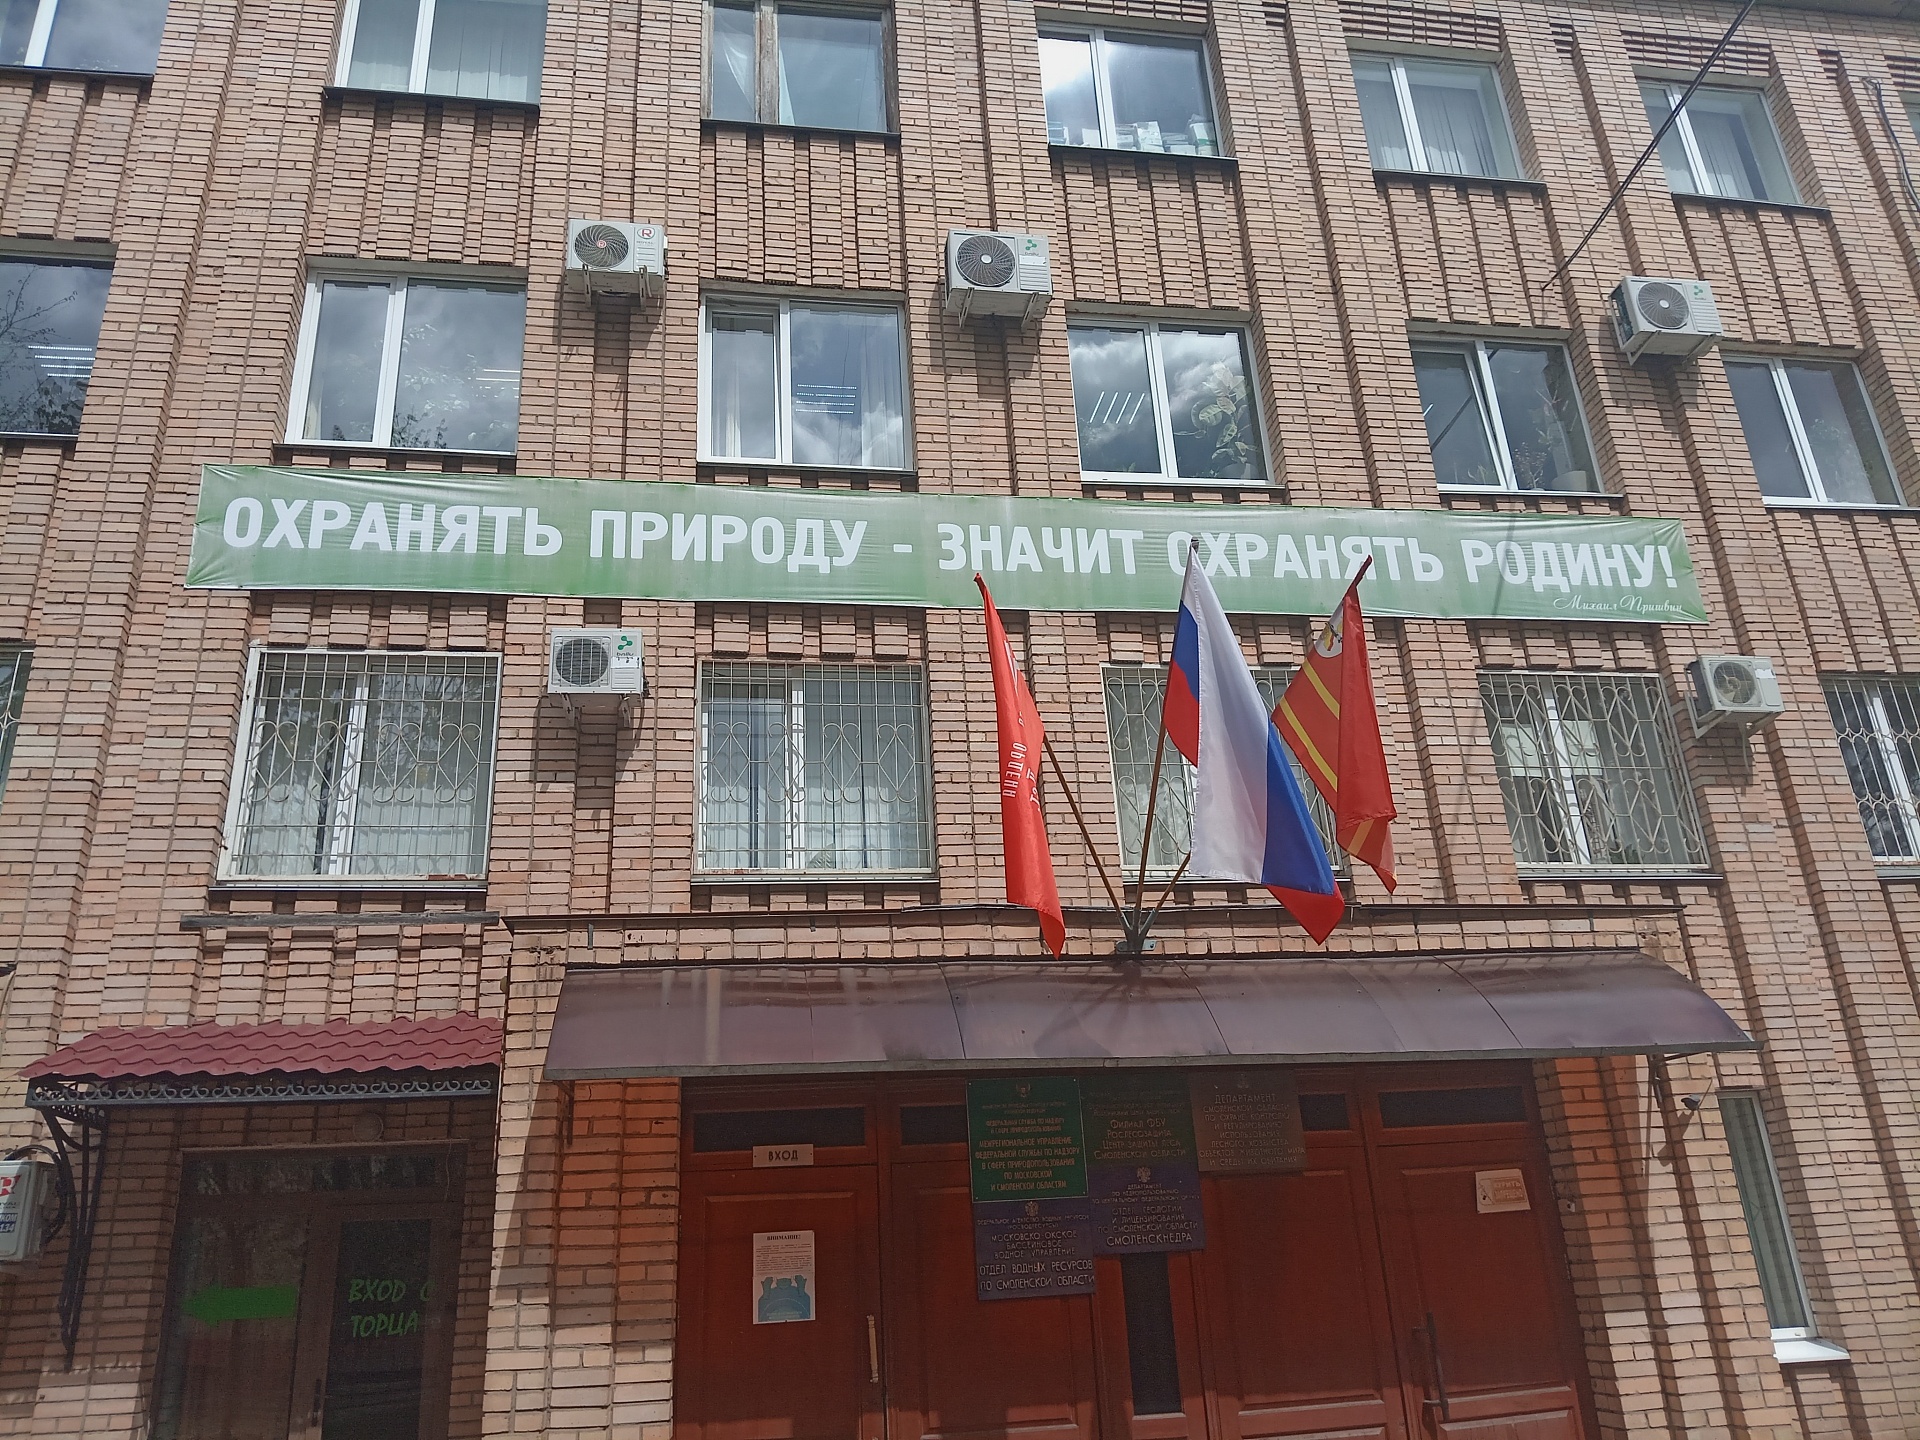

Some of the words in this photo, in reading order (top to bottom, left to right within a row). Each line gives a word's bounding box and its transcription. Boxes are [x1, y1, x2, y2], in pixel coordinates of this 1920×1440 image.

[223, 497, 563, 556] ОХРАНЯТЬ
[590, 510, 867, 573] ПРИРОДУ
[938, 523, 1144, 576] ЗНАЧИТ
[1168, 531, 1444, 582] ОХРАНЯТЬ
[1468, 539, 1679, 594] РОДИНУ!
[1553, 595, 1616, 610] Михаил
[1620, 595, 1682, 614] Пришвин
[1215, 1093, 1275, 1104] ДЕПАРТАМЕНТ
[979, 1138, 1034, 1148] МЕЖРЕГИОНАЛЬНОЕ
[1037, 1137, 1071, 1145] УПРАВЛЕНИЕ
[768, 1150, 798, 1162] ВХОД
[975, 1150, 1016, 1159] ФЕДЕРАЛЬНОЙ
[1054, 1147, 1080, 1155] НАДЗОРУ
[1008, 1158, 1075, 1168] ПРИРОДОПОЛЬЗОВАНИЯ
[1004, 1172, 1012, 1180] ПО
[1015, 1169, 1052, 1179] МОСКОВСКОЙ
[1037, 1180, 1066, 1189] ОБЛАСТЯМ
[1122, 1214, 1184, 1223] ЛИЦЕНЗИРОВАНИЯ
[1166, 1222, 1198, 1230] ОБЛАСТИ
[1107, 1233, 1192, 1246] СМОЛЕНСКНЕДРА
[994, 1251, 1023, 1259] ВОДНОЕ
[1032, 1247, 1075, 1257] УПРАВЛЕНИЕ
[980, 1265, 1006, 1276] ОТДЕЛ
[1012, 1262, 1045, 1274] ВОДНЫХ
[1051, 1260, 1093, 1271] РЕСУРСОВ
[980, 1281, 992, 1290] ПО
[996, 1277, 1052, 1290] СМОЛЕНСКОЙ
[1058, 1275, 1094, 1286] ОБЛАСТИ
[351, 1310, 418, 1338] ТОРЦА
